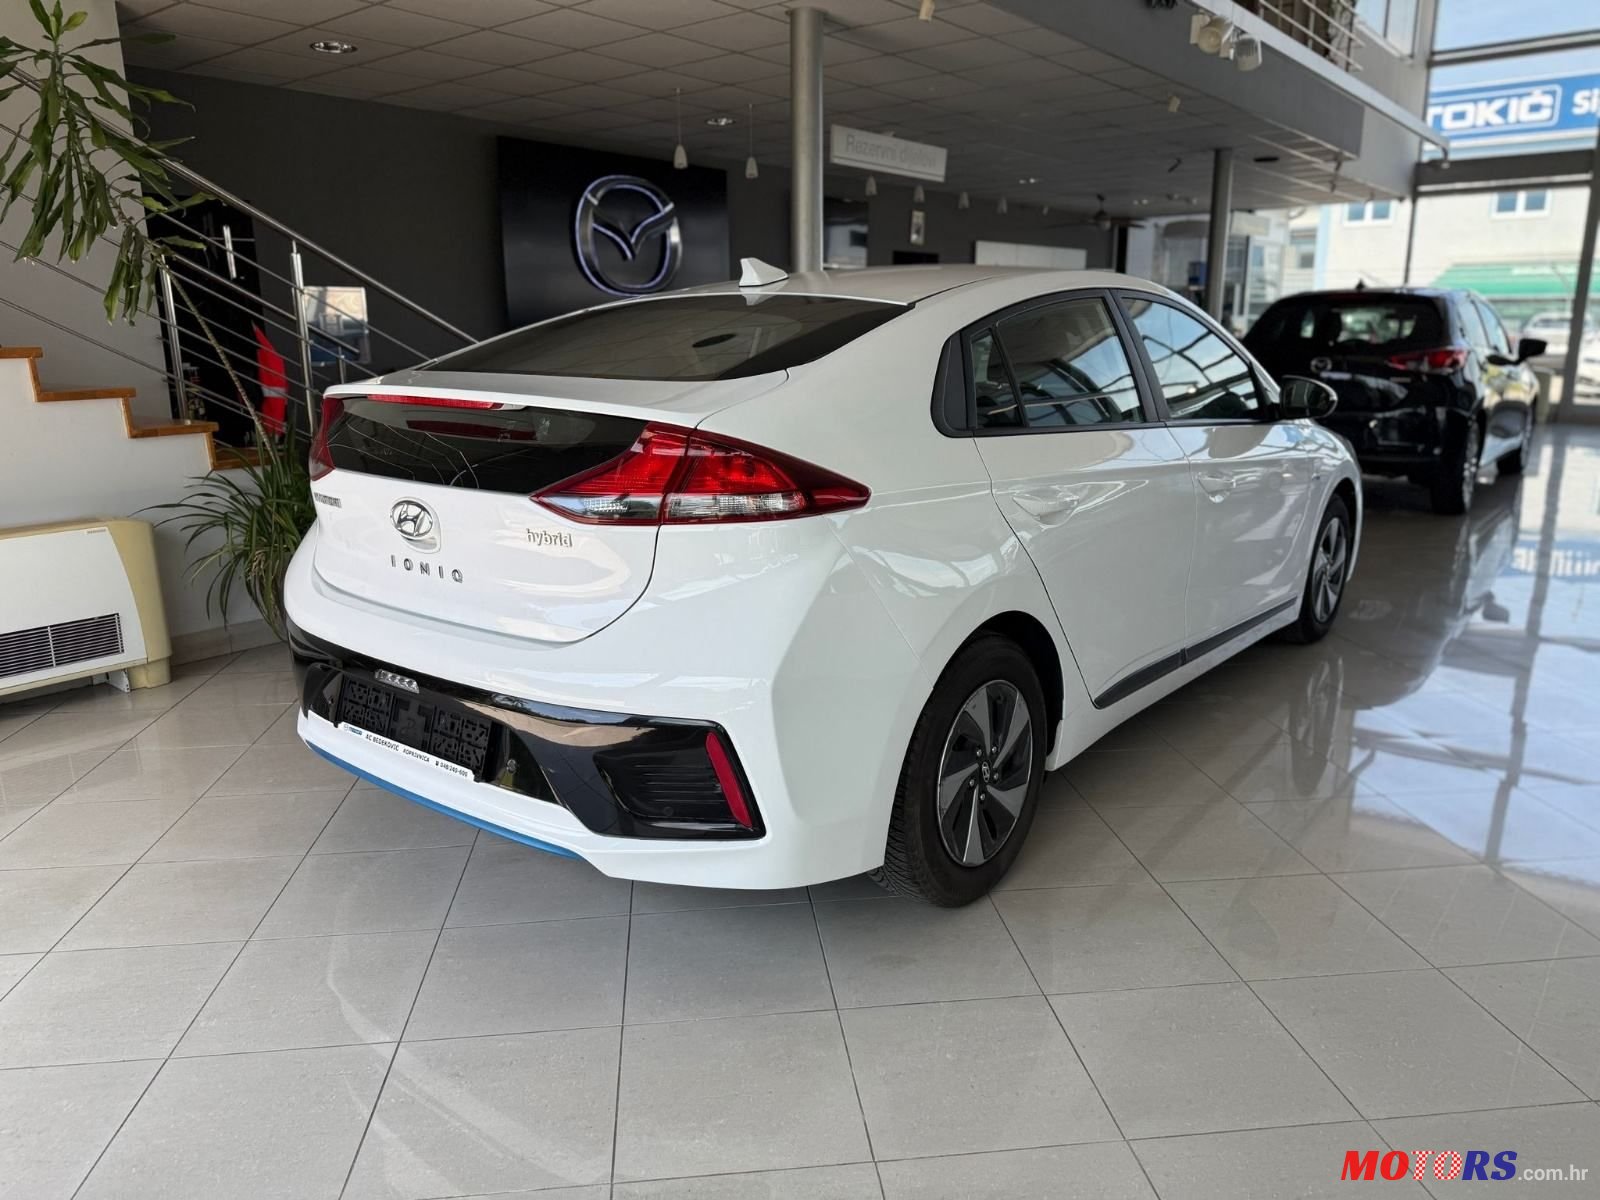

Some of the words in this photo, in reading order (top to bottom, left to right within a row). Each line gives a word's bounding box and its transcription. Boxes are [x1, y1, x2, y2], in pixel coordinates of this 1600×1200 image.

[1427, 88, 1554, 130] TOKIĆ
[526, 528, 573, 548] hybrid
[390, 555, 463, 583] IONIQ
